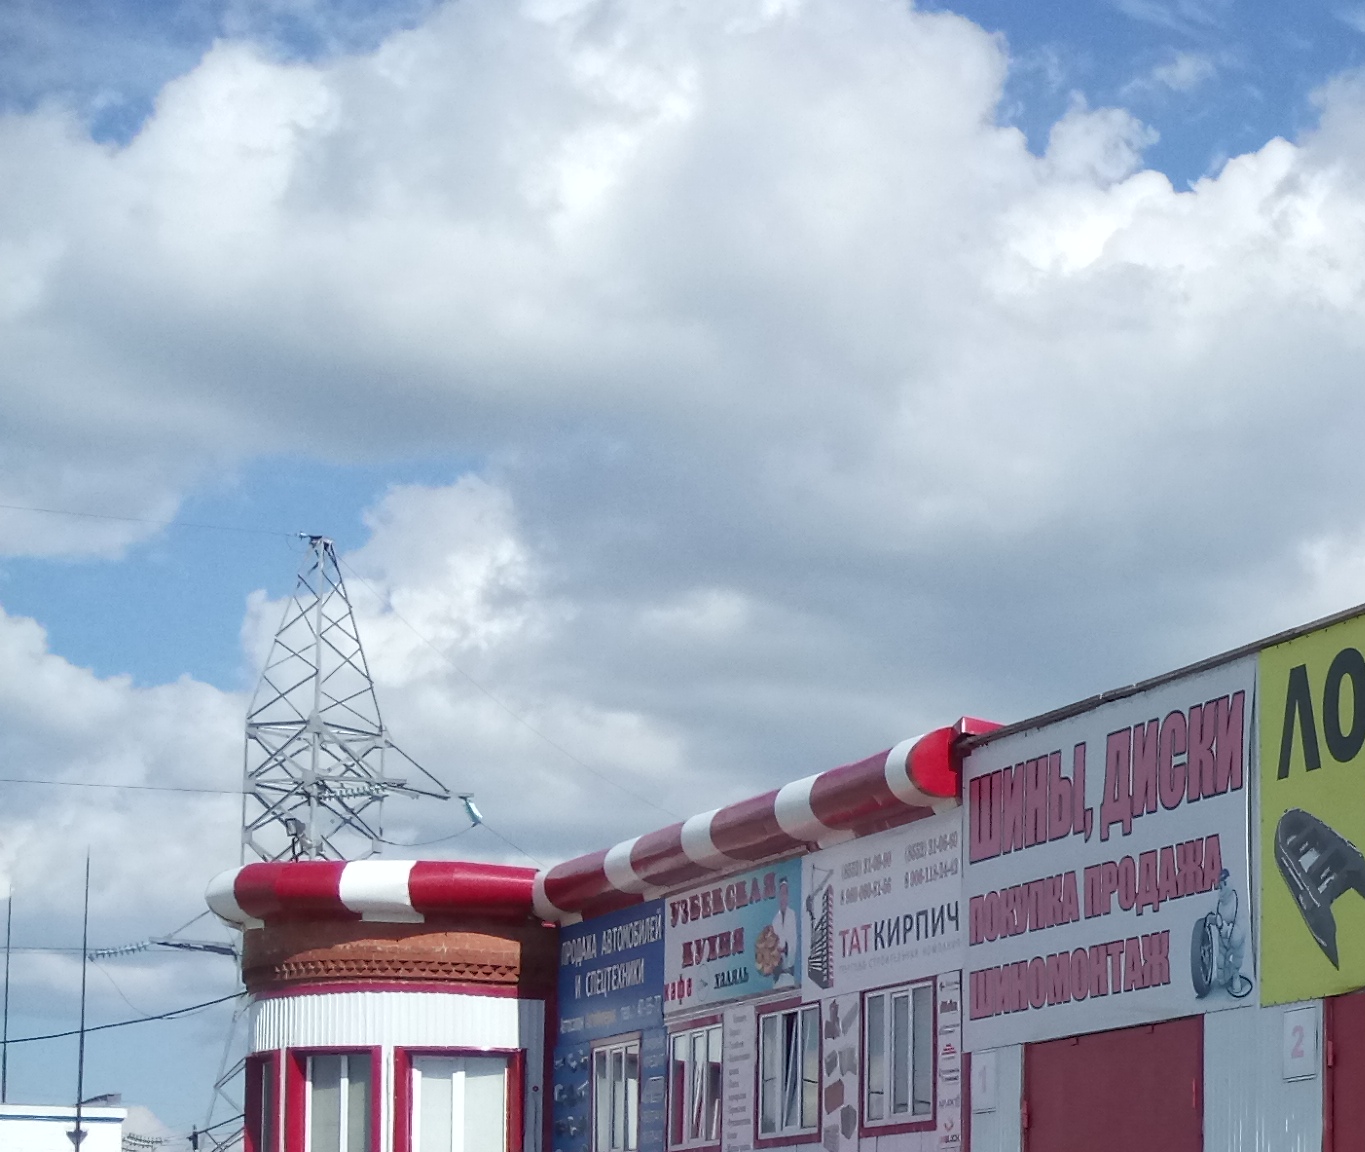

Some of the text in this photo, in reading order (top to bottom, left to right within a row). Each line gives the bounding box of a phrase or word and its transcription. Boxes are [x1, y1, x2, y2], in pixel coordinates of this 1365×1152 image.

[969, 690, 1246, 865] ШИНЫ, ДИСКИ
[670, 872, 777, 928] УЗБЕКСКАЯ
[969, 834, 1224, 947] ПОКУПКА ПРОДАЖА
[561, 907, 662, 967] ПРОДАЖА АВТОМОБИЛЕЙ
[682, 927, 745, 968] КУХНЯ
[839, 901, 960, 958] ТАТКИРПИЧ
[575, 958, 645, 999] И СПЕЦТЕХНИКИ
[969, 930, 1171, 1021] ШИНОМОНТАЖ
[1291, 1025, 1304, 1058] 2
